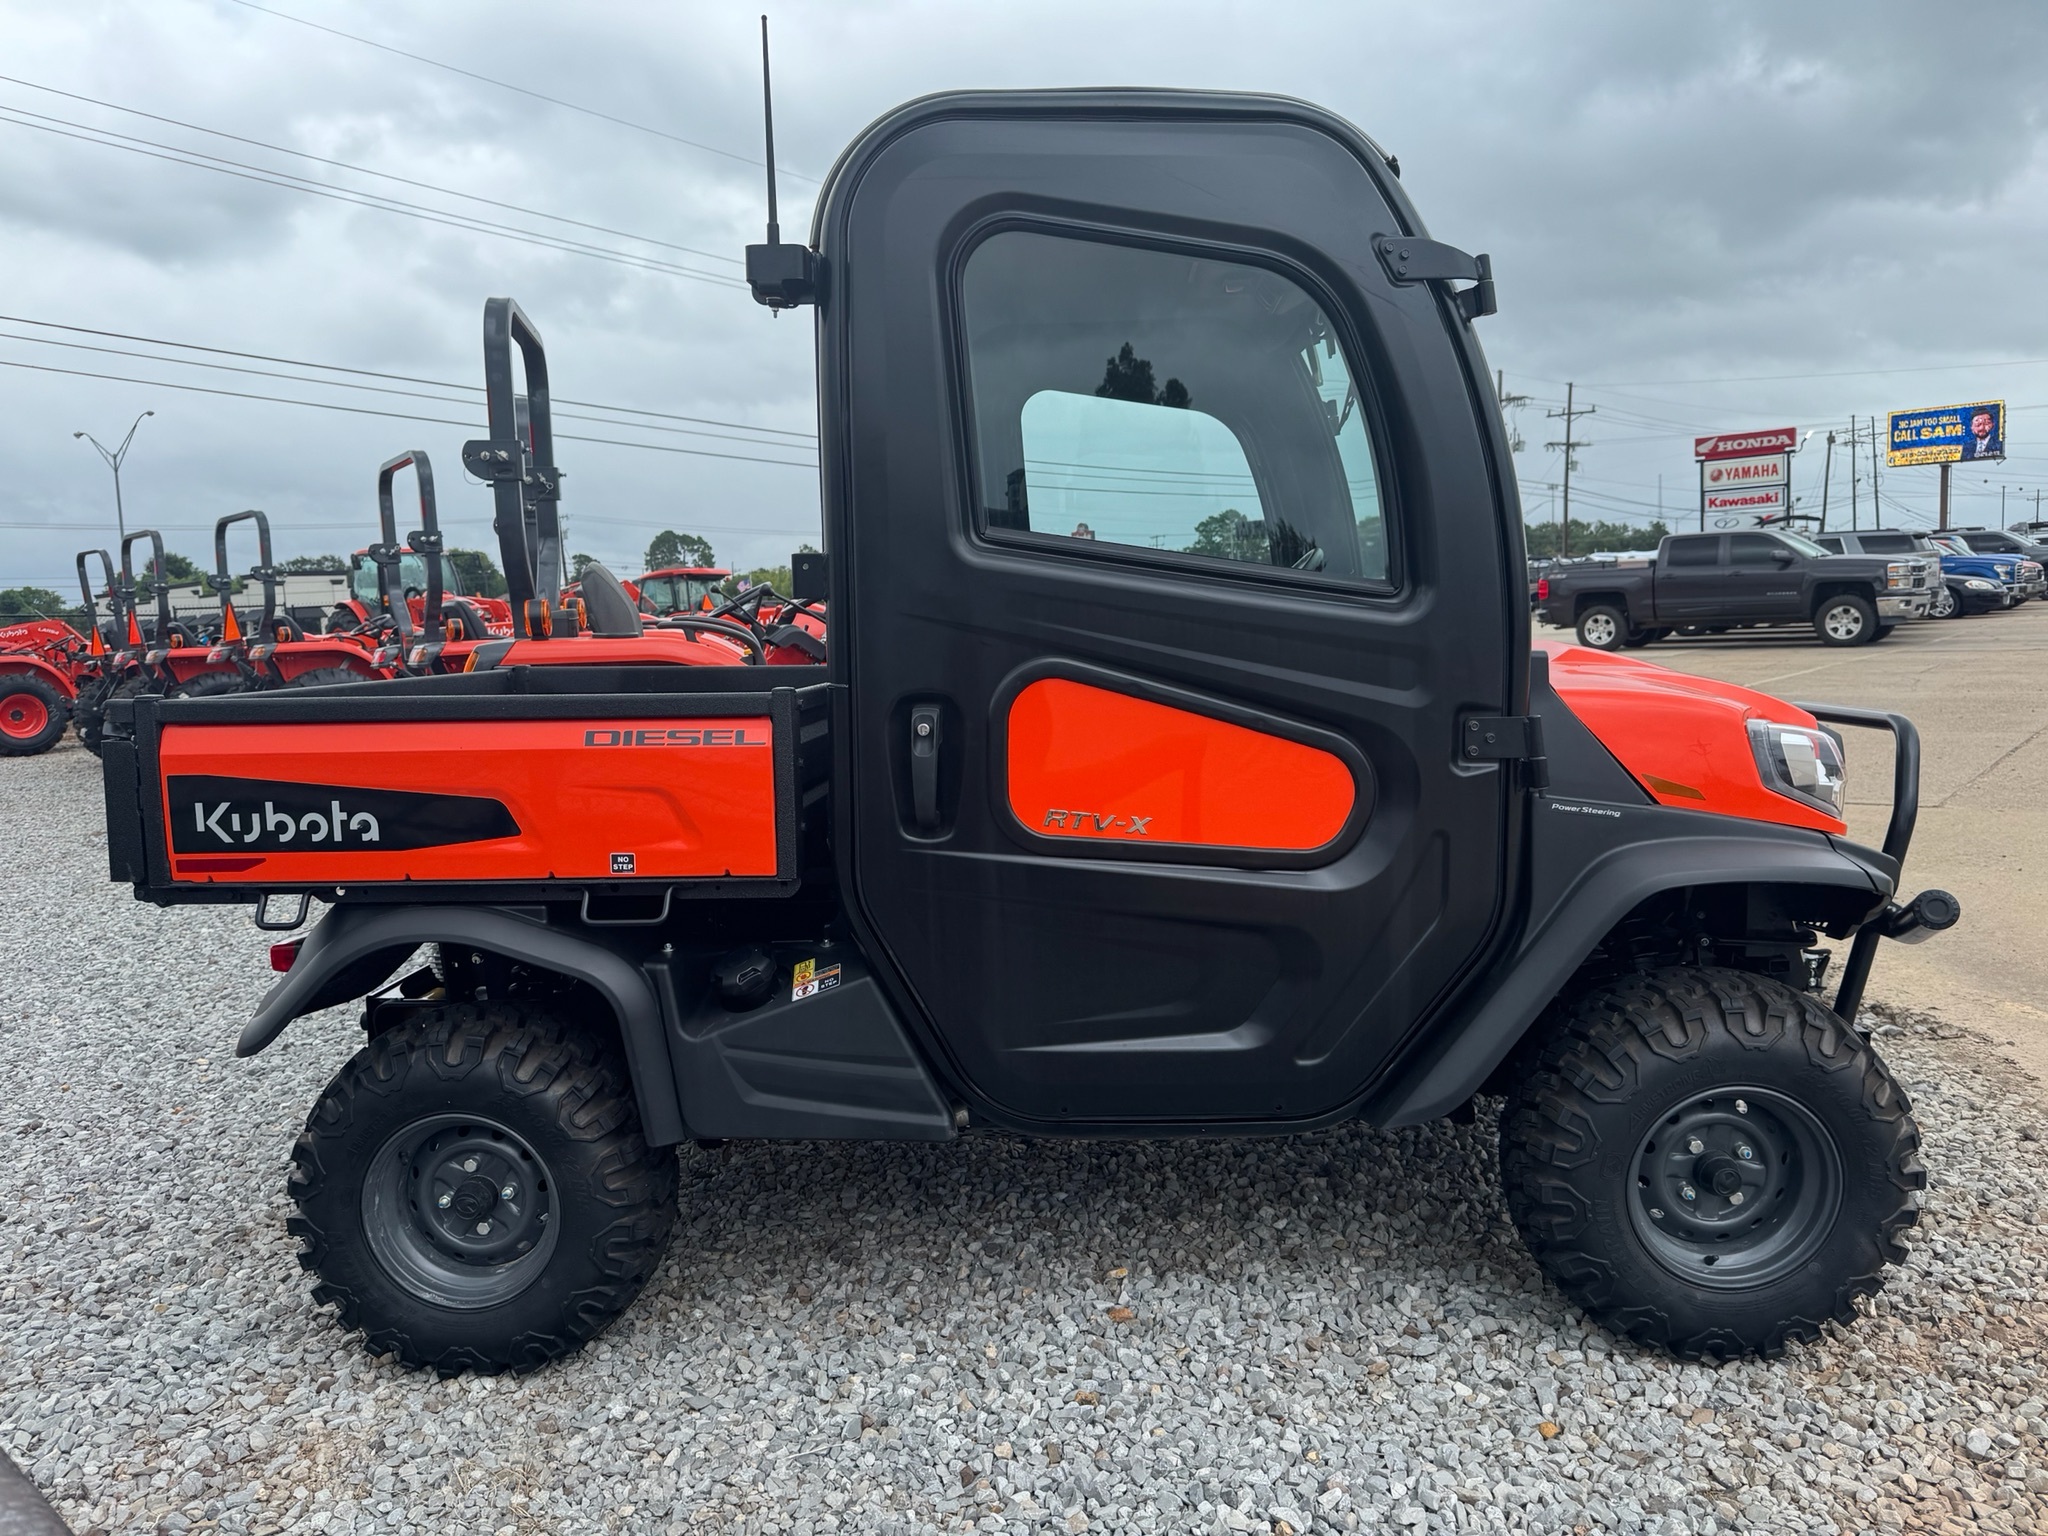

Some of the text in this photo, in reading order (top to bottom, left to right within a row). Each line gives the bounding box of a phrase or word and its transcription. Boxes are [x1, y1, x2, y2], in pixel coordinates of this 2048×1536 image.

[1923, 417, 1938, 426] TOO
[1717, 434, 1793, 452] HONDA
[1894, 428, 1919, 443] CALL
[1724, 463, 1779, 480] YAMAHA
[1708, 491, 1779, 508] Kawasaki
[584, 729, 767, 747] DIESEL
[1551, 803, 1621, 817] Power Steering
[194, 800, 380, 843] Kubota
[1043, 808, 1153, 835] RTV-X
[613, 863, 634, 871] STEP
